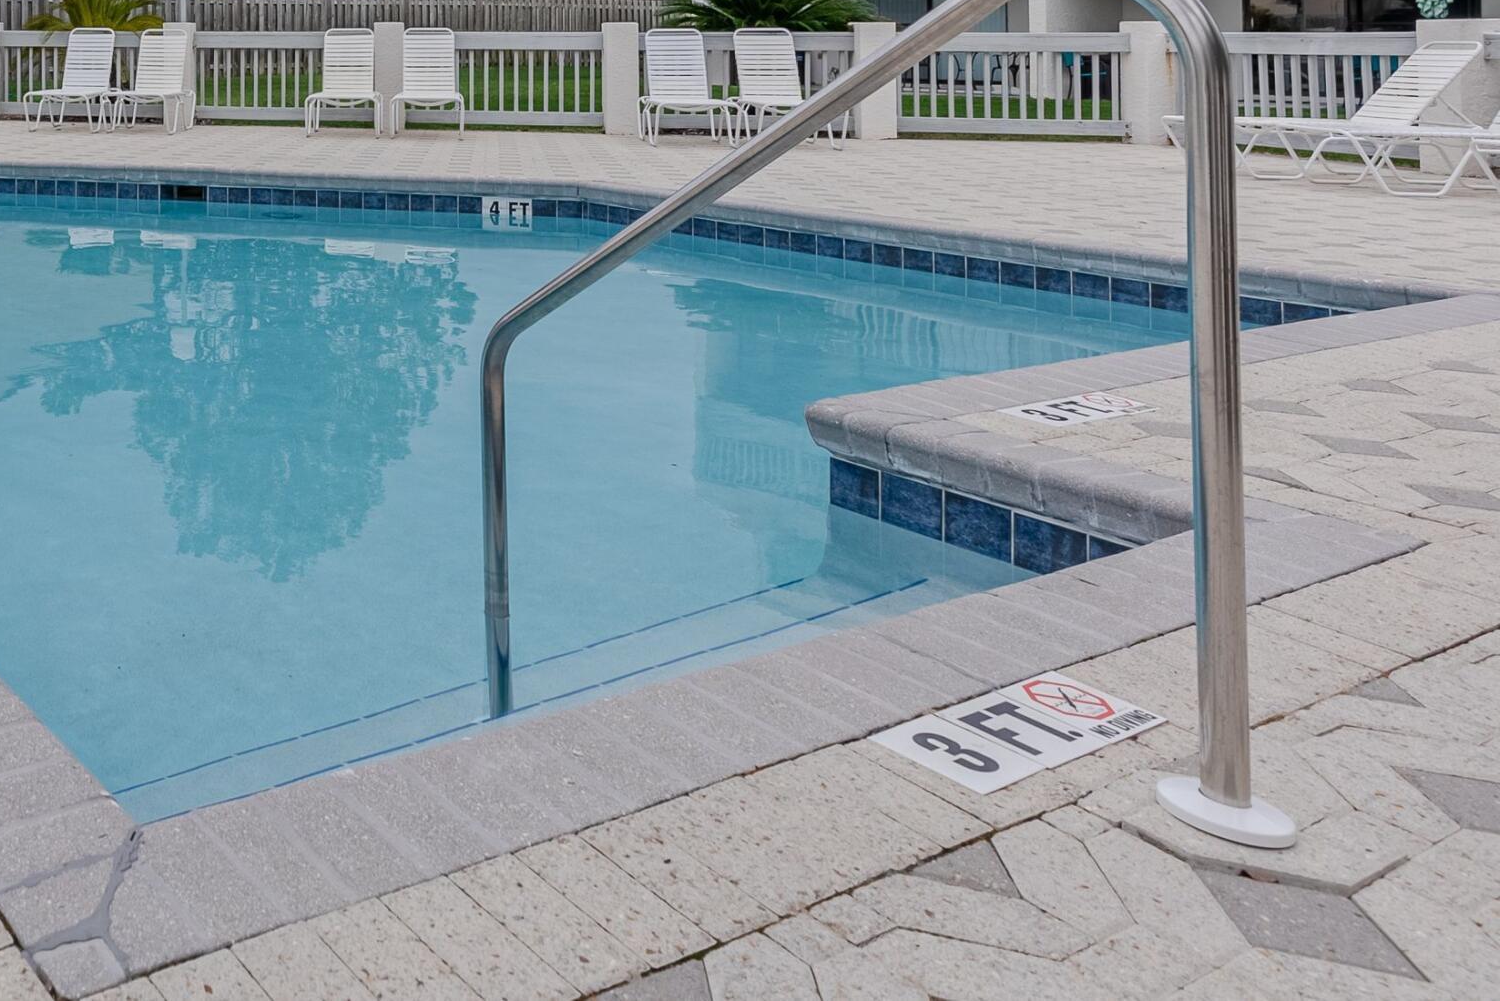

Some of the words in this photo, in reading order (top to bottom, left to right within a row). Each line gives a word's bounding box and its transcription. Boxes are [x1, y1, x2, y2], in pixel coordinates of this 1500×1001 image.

[489, 201, 500, 217] 4
[1021, 408, 1069, 422] 3
[1088, 724, 1120, 739] NO
[1106, 709, 1157, 731] DIVING
[911, 732, 1000, 773] 3
[958, 700, 1084, 756] FT.
